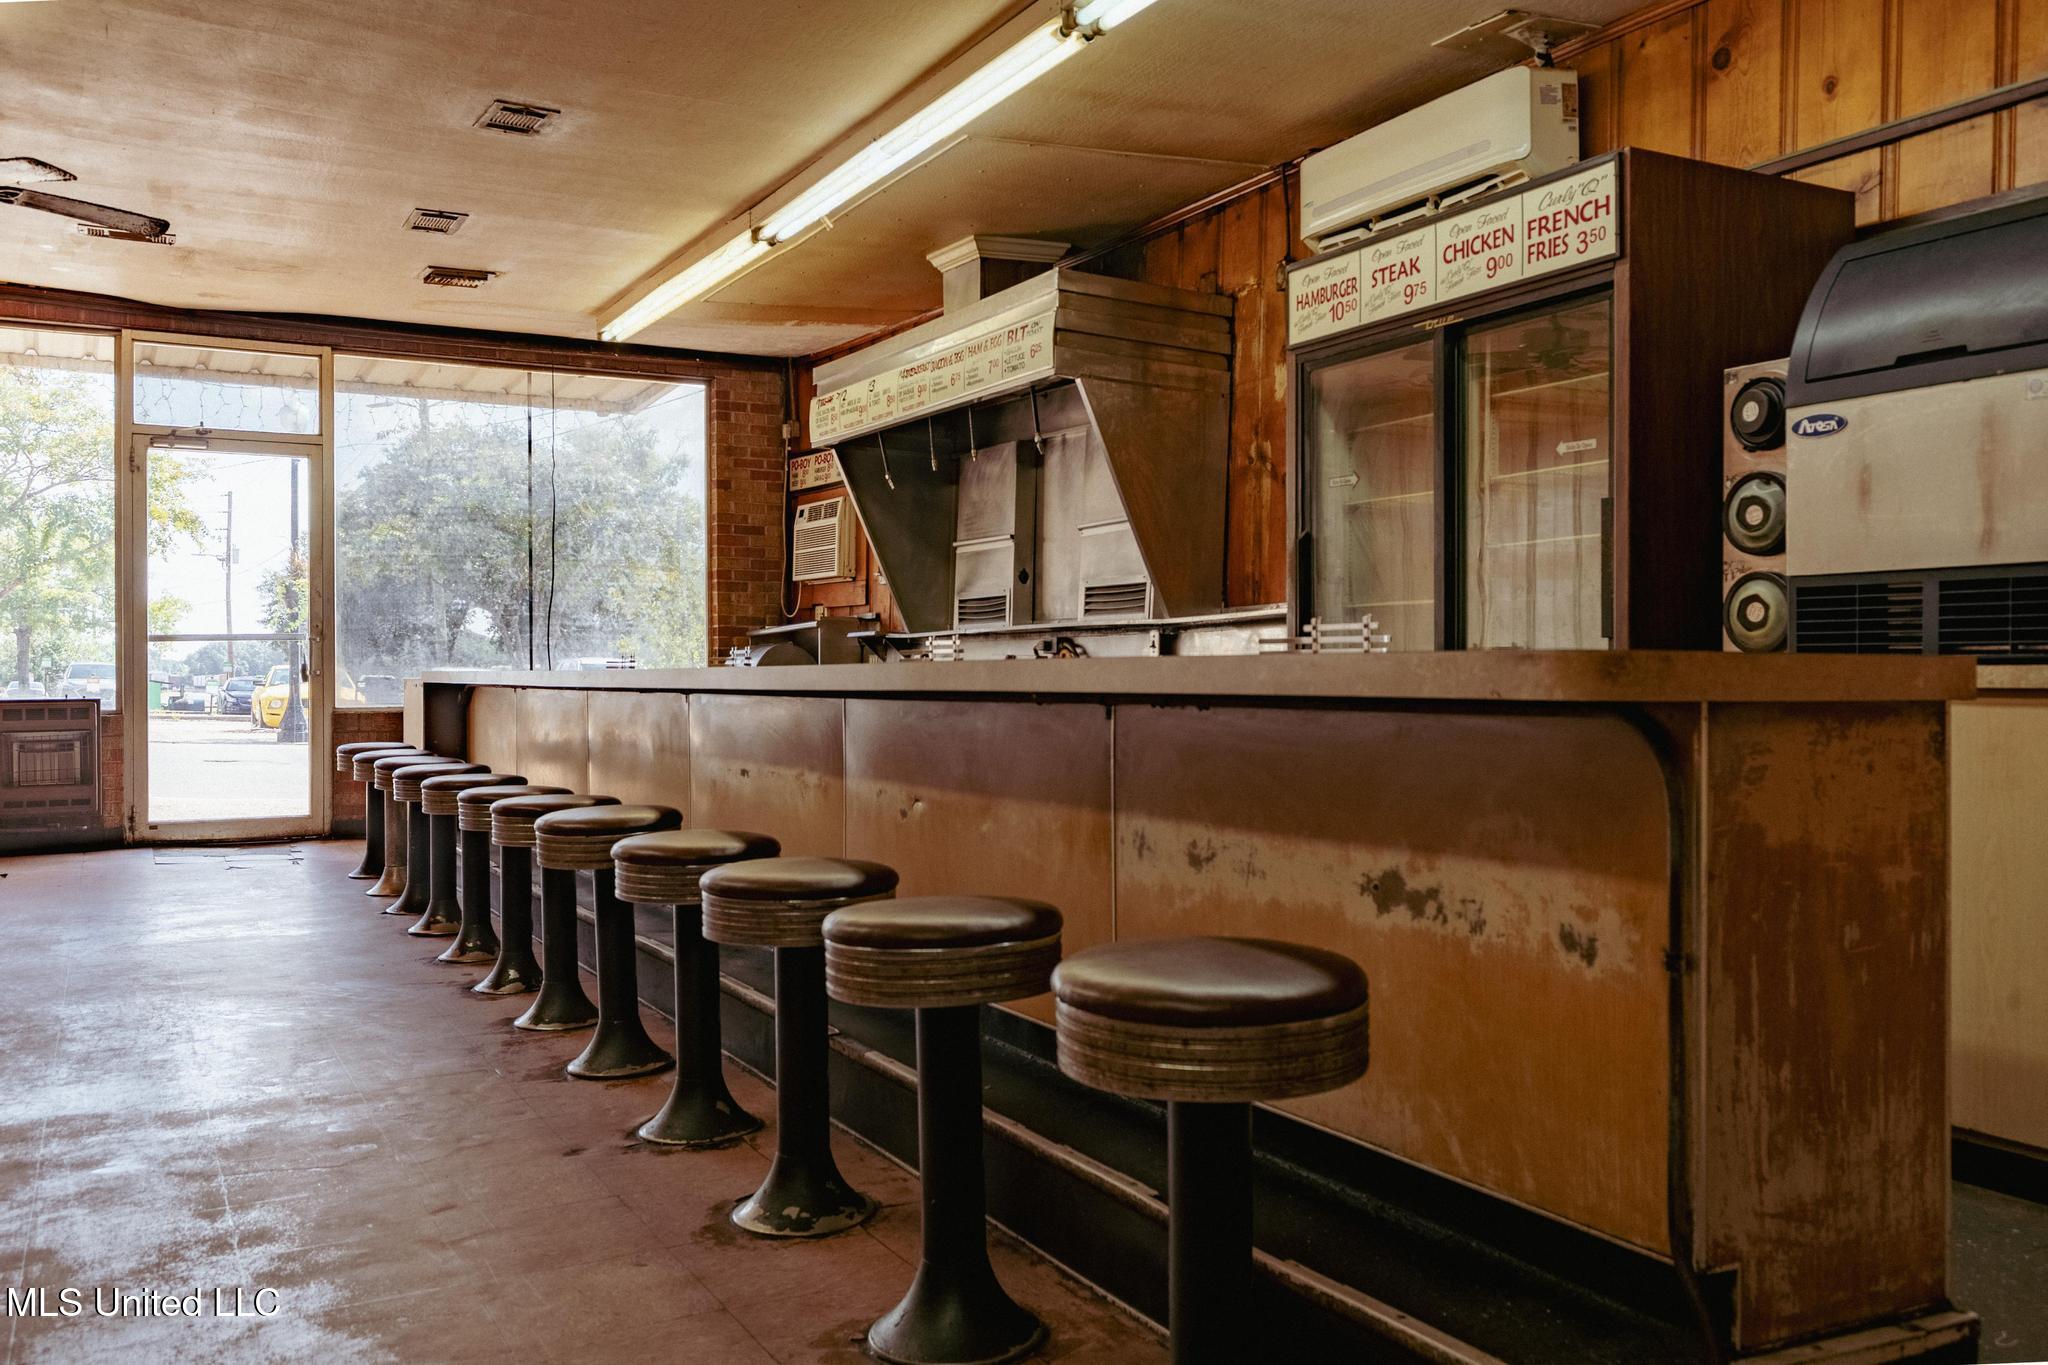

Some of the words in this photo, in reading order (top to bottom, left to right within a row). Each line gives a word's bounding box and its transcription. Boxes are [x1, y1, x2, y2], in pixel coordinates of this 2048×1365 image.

[1538, 185, 1577, 211] Curly
[1527, 194, 1610, 240] FRENCH
[1443, 224, 1514, 264] CHICKEN
[1527, 233, 1569, 264] FRIES
[1371, 256, 1421, 288] STEAK
[1296, 276, 1358, 312] HAMBURGER
[1007, 324, 1029, 346] BLT
